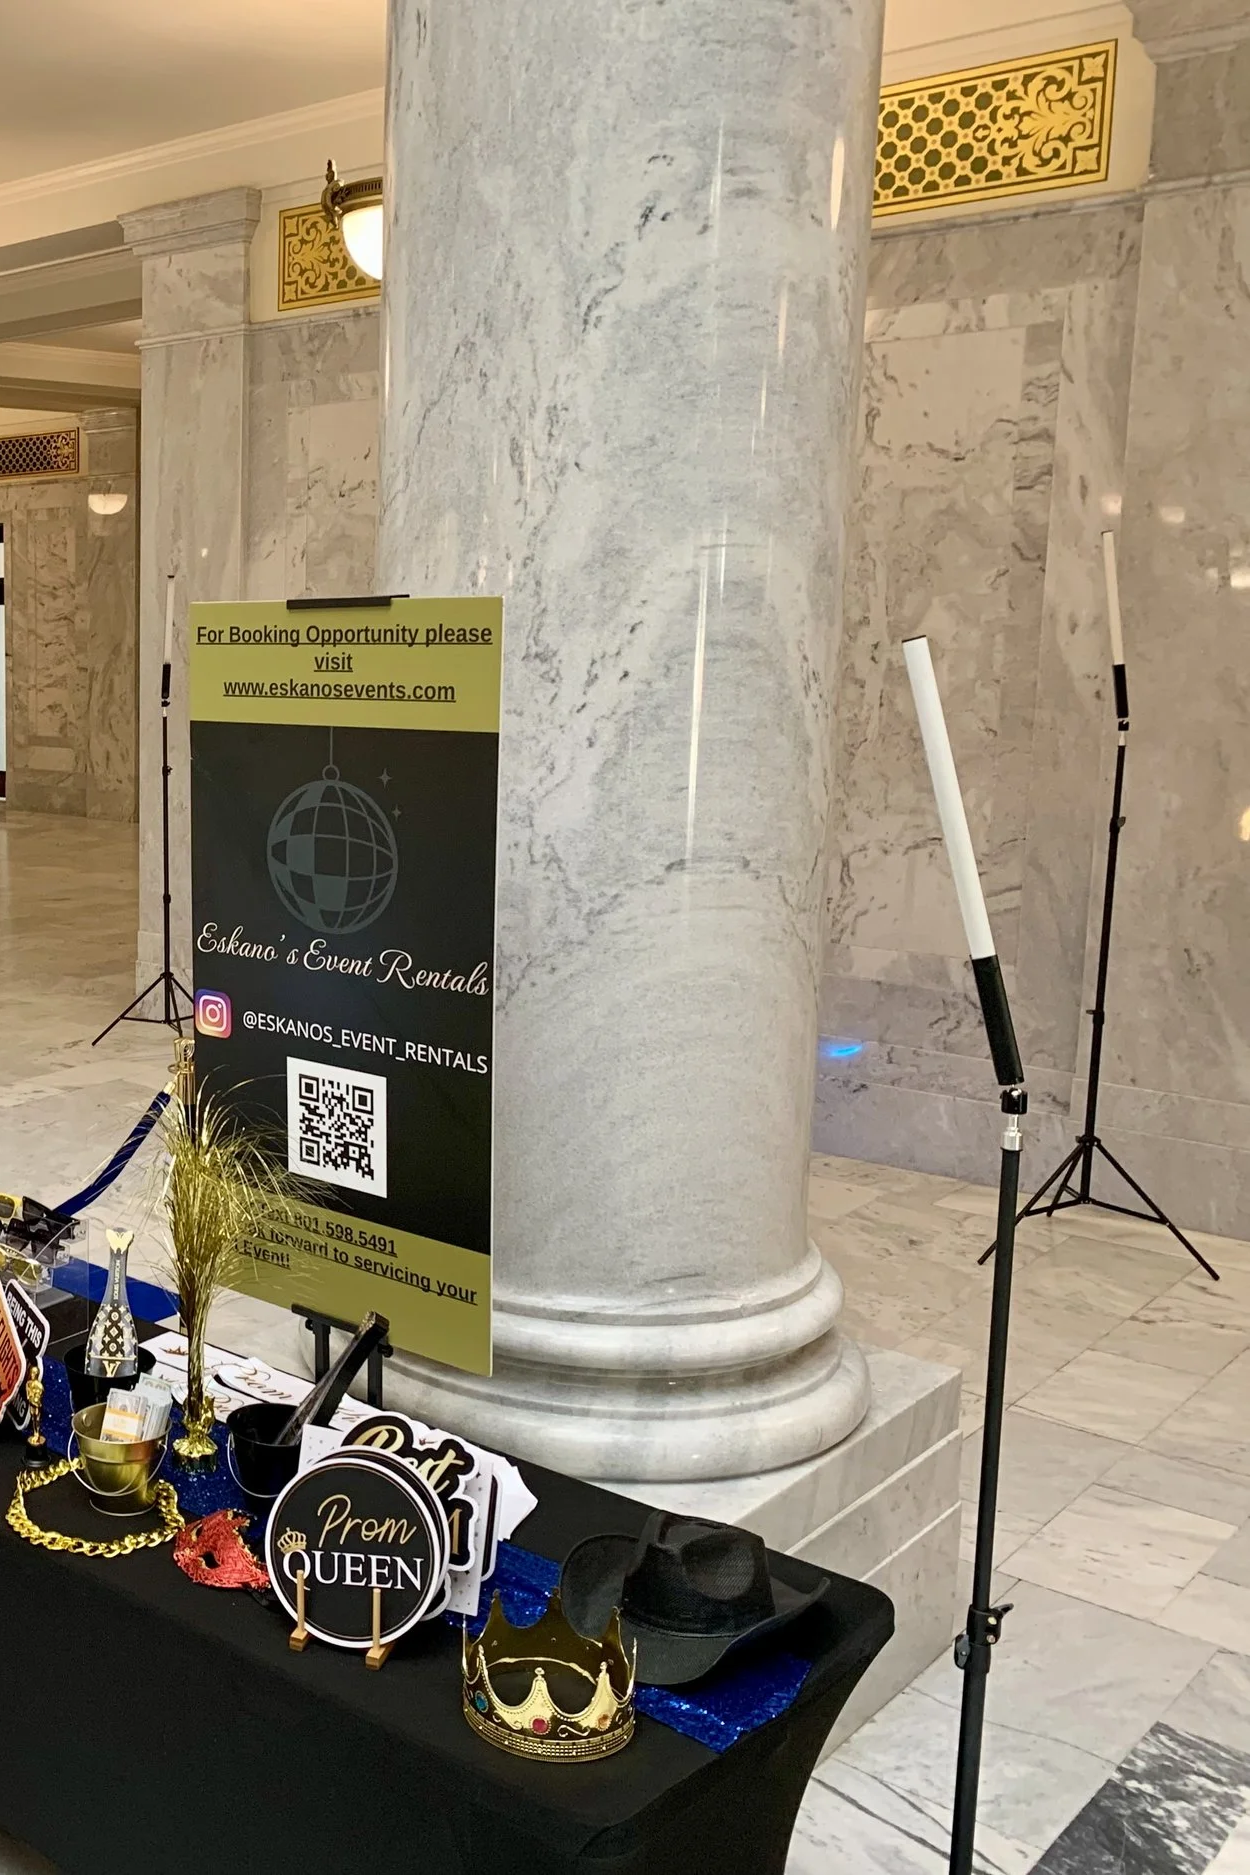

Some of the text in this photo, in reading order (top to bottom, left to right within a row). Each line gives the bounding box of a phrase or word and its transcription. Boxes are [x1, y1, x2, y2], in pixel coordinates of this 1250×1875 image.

[196, 624, 493, 648] For Booking Opportunity please
[313, 652, 353, 672] visit
[223, 680, 456, 702] www.eskanosevents.com
[302, 937, 373, 978] Event
[372, 948, 490, 996] Rentals
[242, 1011, 490, 1075] @ESKANOS_EVENT_RENTALS
[243, 1239, 291, 1268] Event!
[293, 1211, 397, 1256] 801.598.5491
[270, 1230, 329, 1258] forward
[333, 1248, 350, 1265] to
[354, 1254, 432, 1293] servicing
[436, 1279, 478, 1305] your
[6, 1291, 43, 1349] BEING THIS
[316, 1493, 418, 1549] Prom
[281, 1548, 425, 1593] QUEEN
